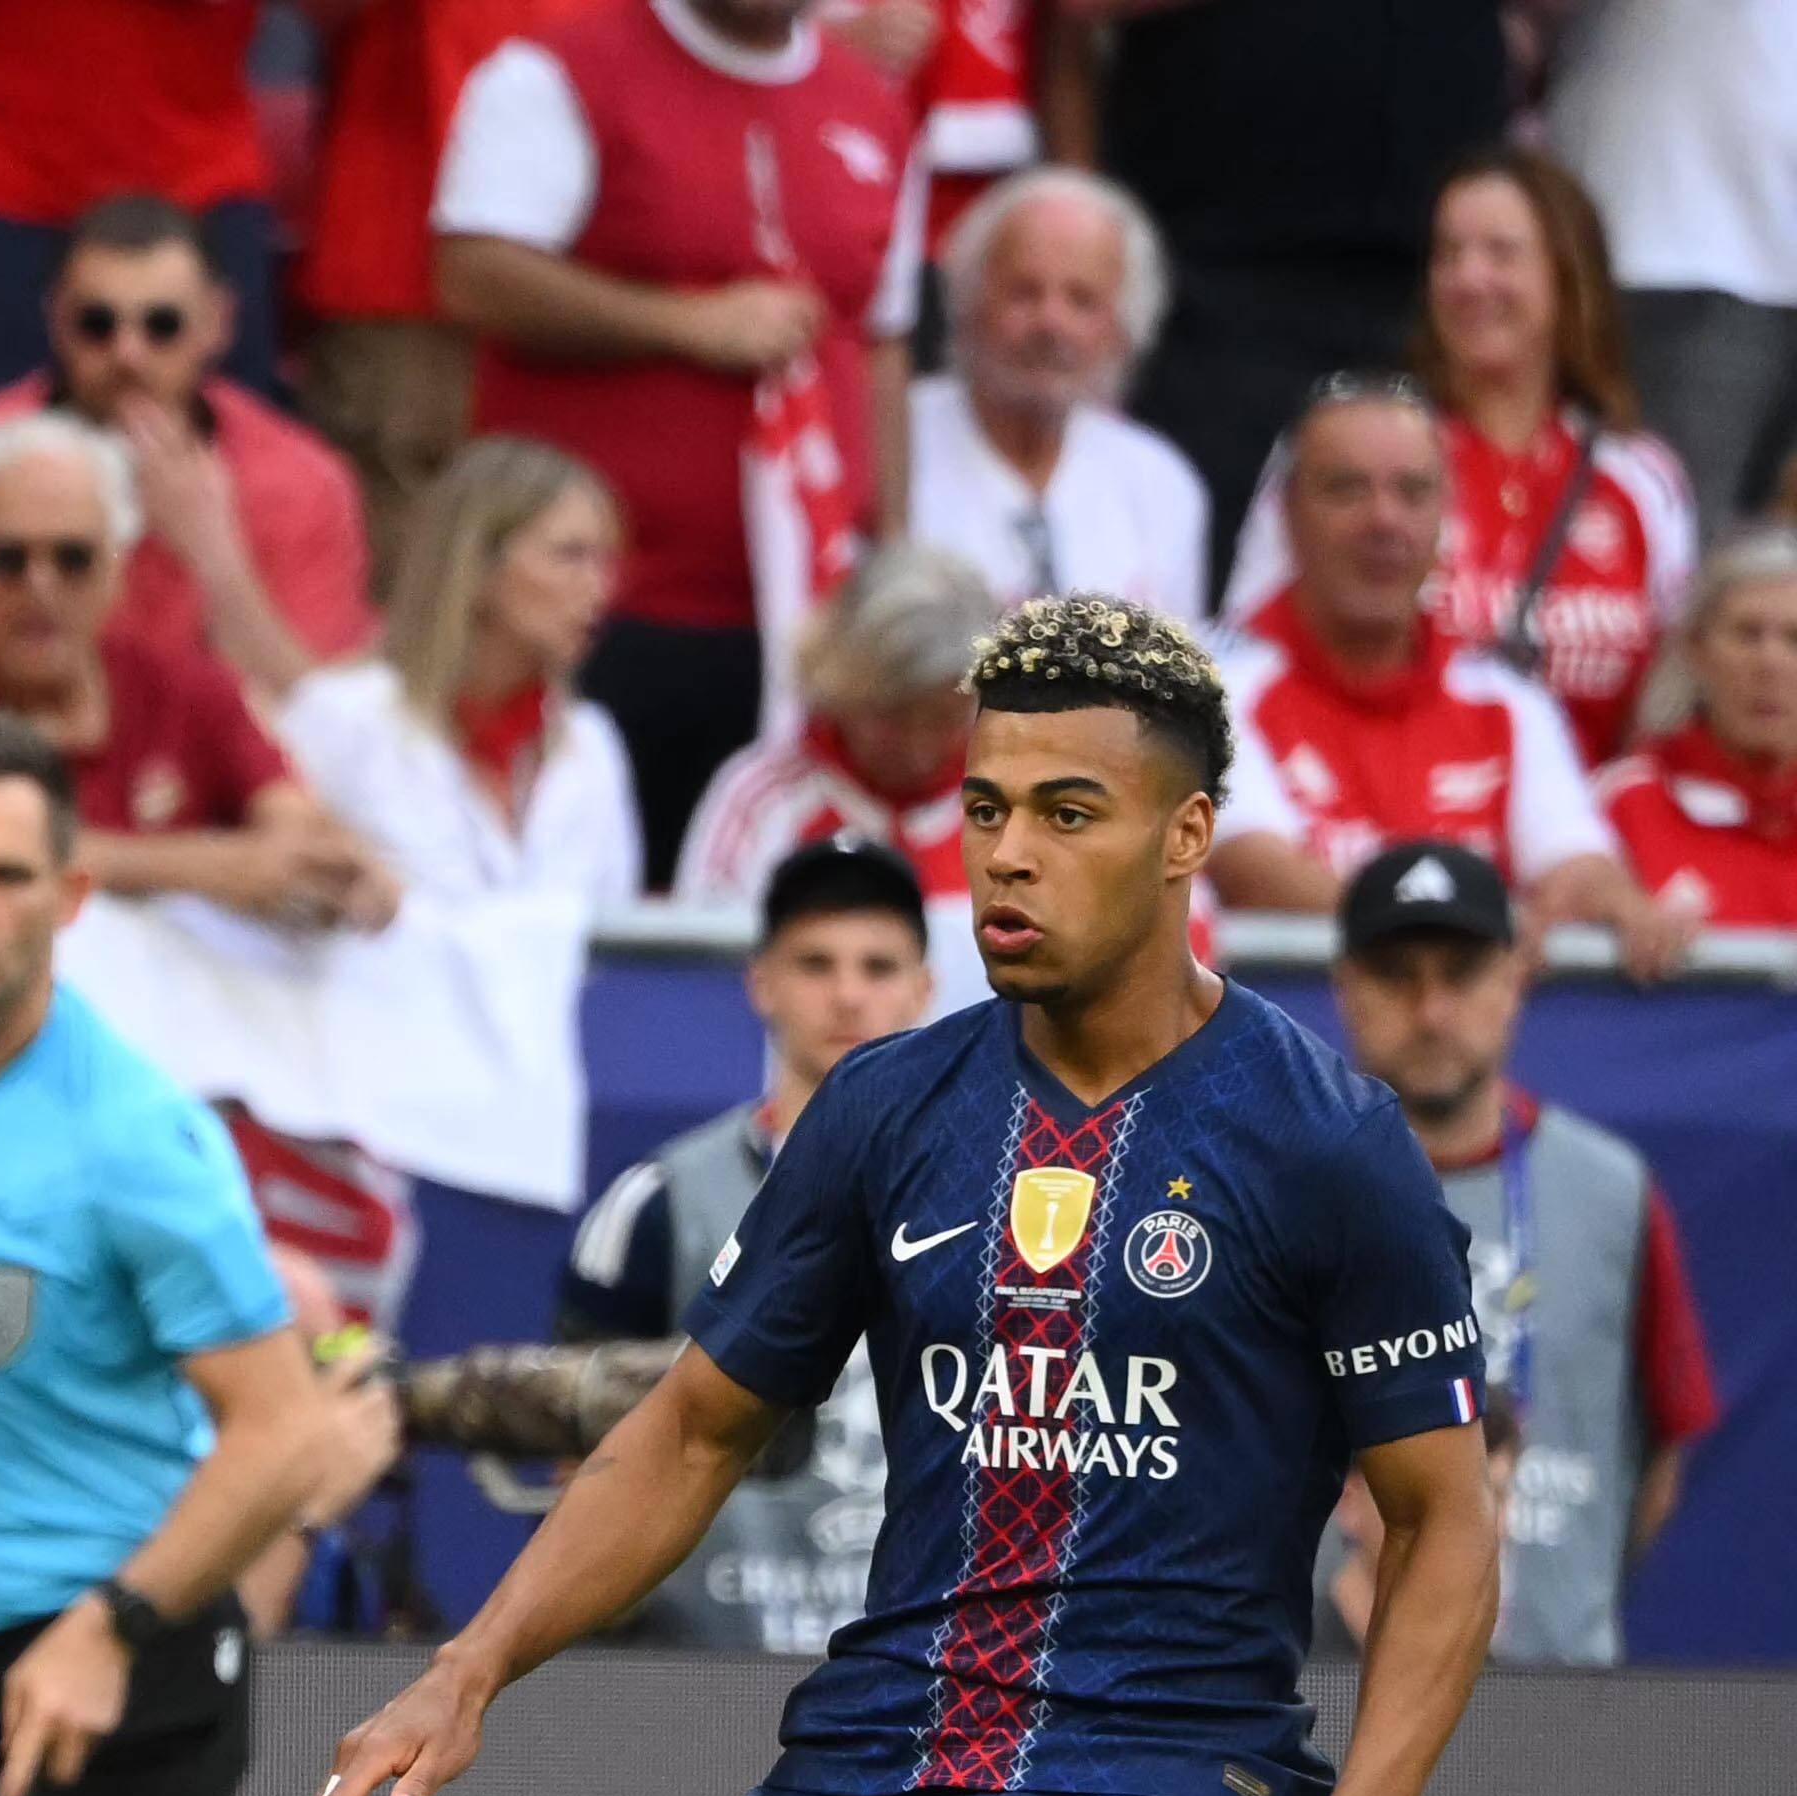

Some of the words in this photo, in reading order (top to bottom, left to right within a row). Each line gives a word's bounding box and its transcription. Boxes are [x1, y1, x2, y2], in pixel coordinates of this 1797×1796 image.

[1143, 1215, 1200, 1240] PARIS
[919, 1342, 1182, 1433] QATAR
[959, 1422, 1180, 1480] AIRWAYS
